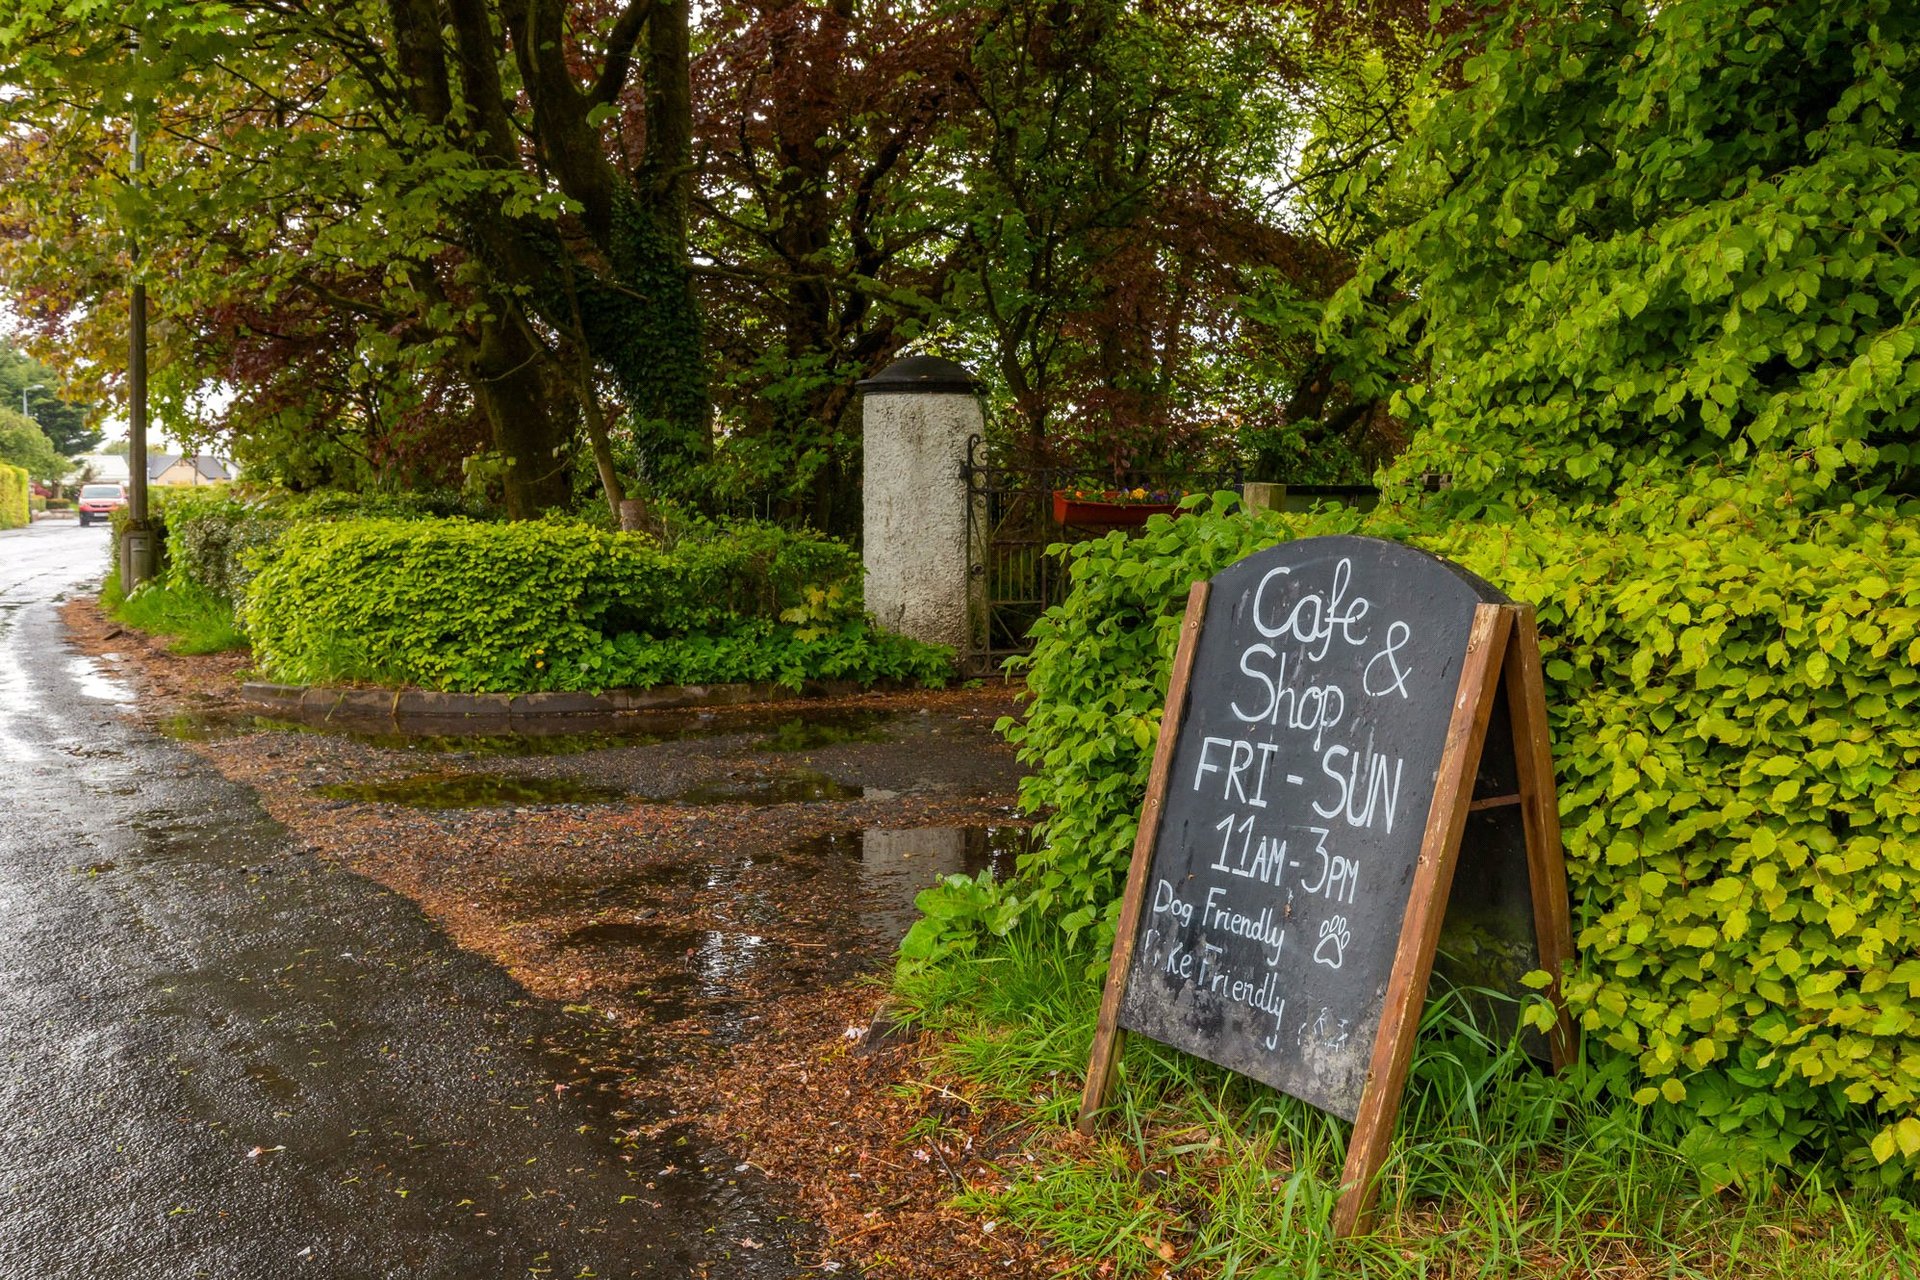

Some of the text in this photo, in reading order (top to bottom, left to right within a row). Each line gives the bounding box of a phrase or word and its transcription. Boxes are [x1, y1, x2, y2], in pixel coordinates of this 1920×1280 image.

[1253, 558, 1412, 698] Cafe &
[1231, 643, 1344, 751] Shop
[1193, 736, 1278, 808] FRI
[1311, 744, 1403, 834] SUN
[1153, 879, 1285, 966] Dog Friendly
[1198, 943, 1285, 1050] Friendly
